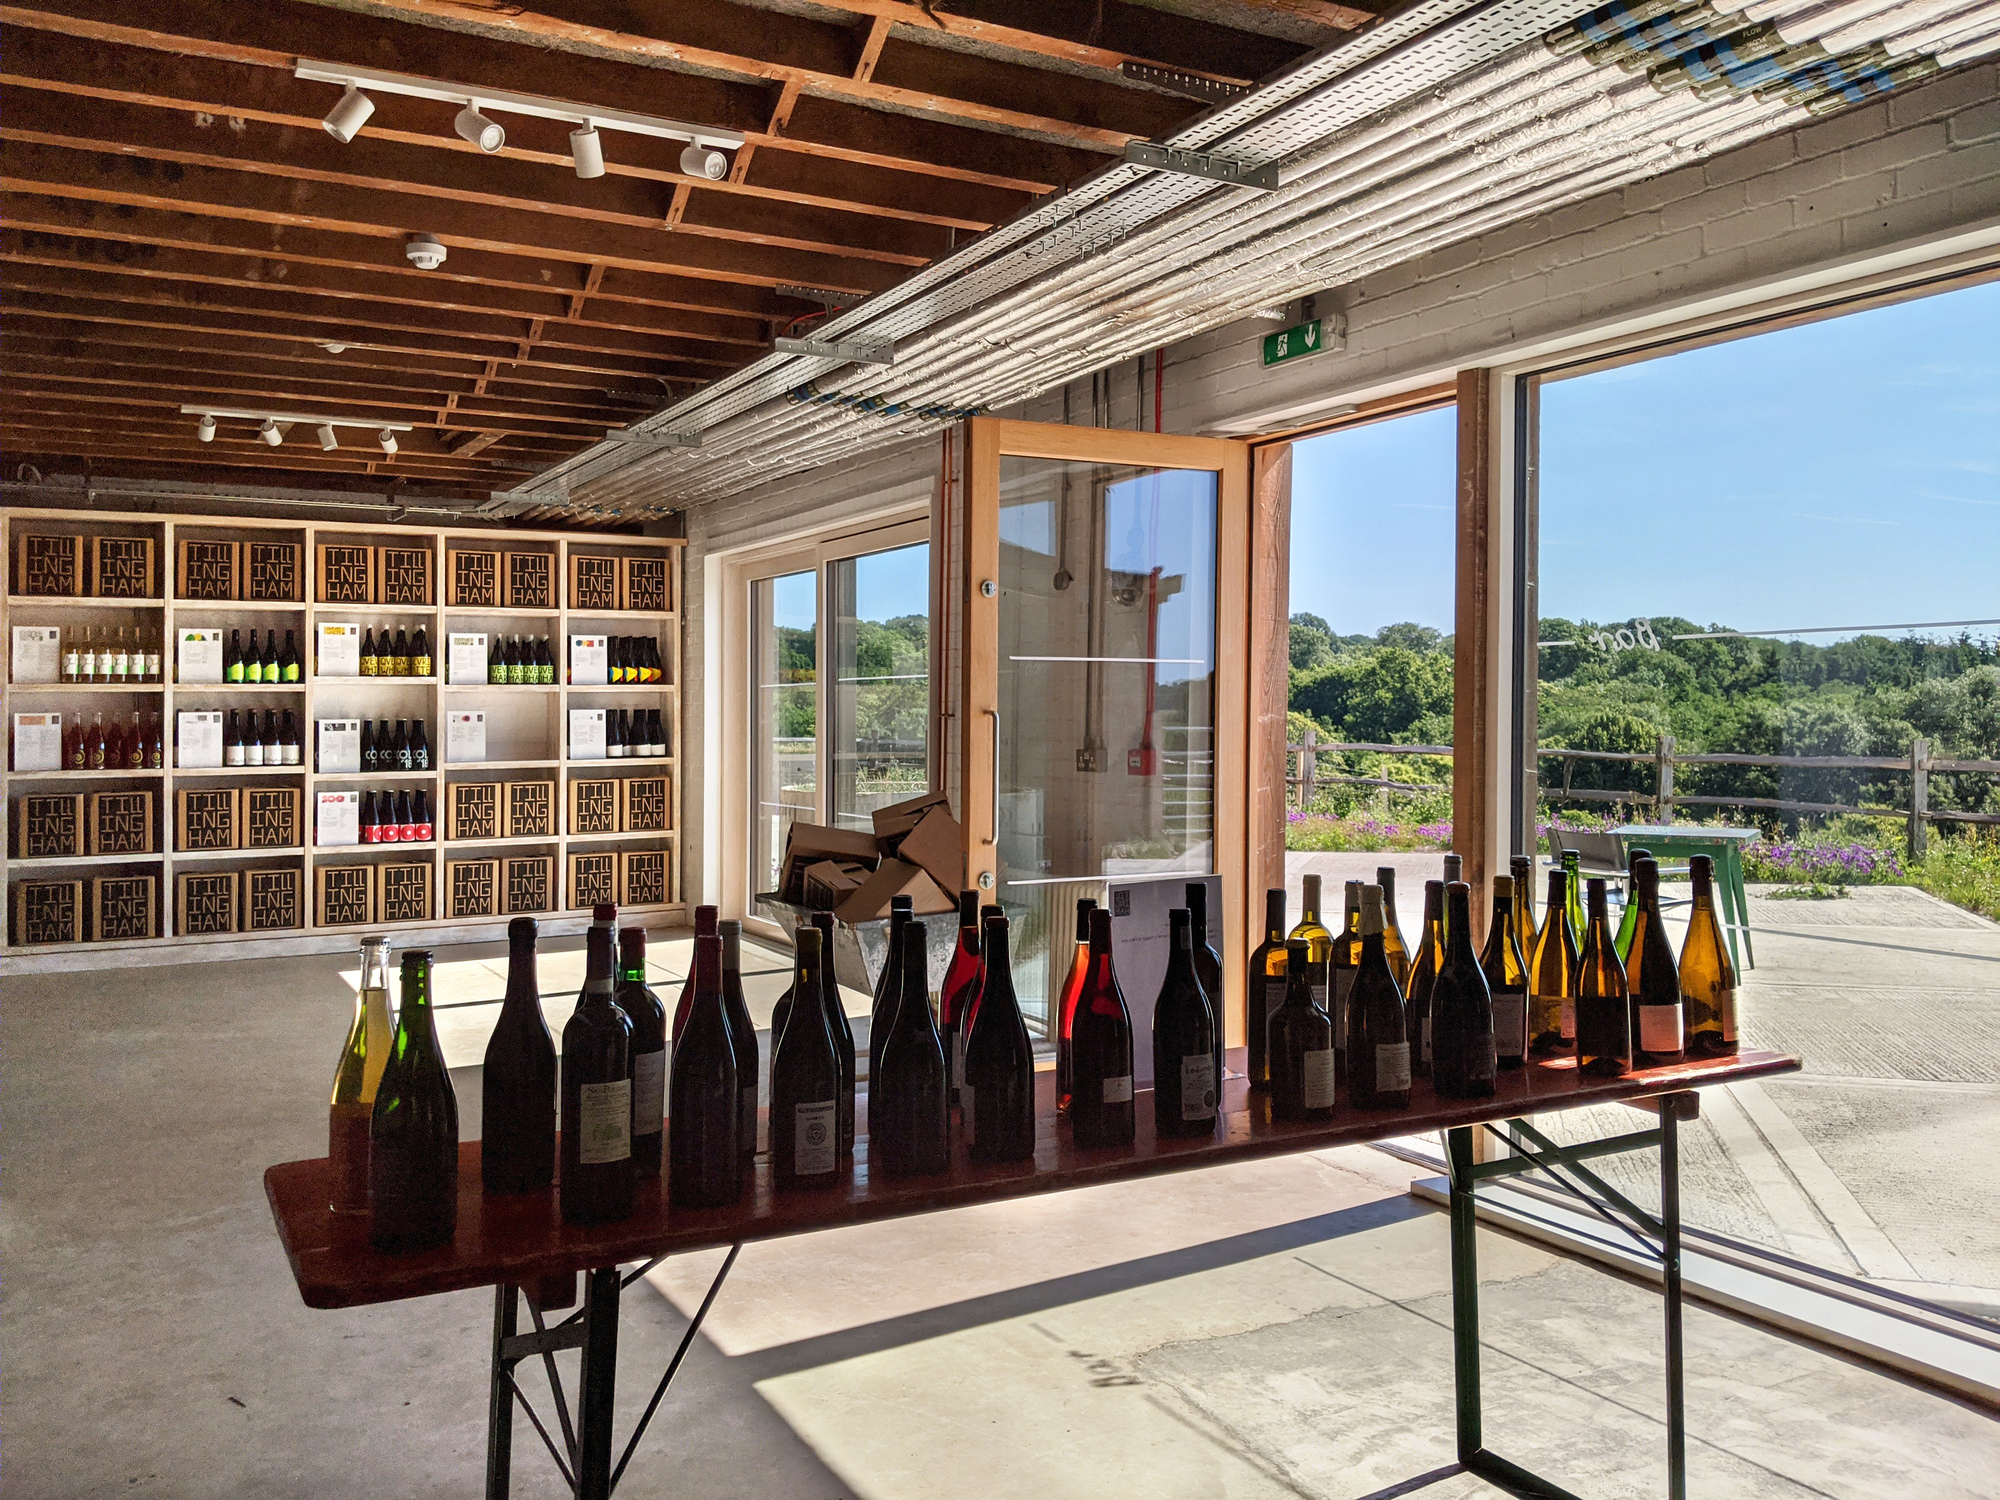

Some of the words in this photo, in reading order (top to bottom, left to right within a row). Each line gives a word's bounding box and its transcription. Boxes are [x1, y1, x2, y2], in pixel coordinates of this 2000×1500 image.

[1743, 26, 1762, 38] FLOW
[103, 542, 144, 559] TILL
[190, 544, 229, 562] TILL
[253, 546, 292, 563] TILL
[328, 549, 365, 565] TILL
[30, 556, 72, 574] ING
[387, 552, 423, 568] TILL
[458, 554, 492, 570] TILL
[513, 556, 546, 572] TILL
[580, 560, 612, 576] TILL
[103, 560, 144, 577] ING
[190, 562, 230, 579] ING
[254, 563, 292, 580] ING
[328, 566, 365, 582] ING
[631, 562, 662, 577] TILL
[30, 576, 73, 593] HAM
[387, 569, 424, 585] ING
[458, 571, 492, 587] ING
[513, 572, 547, 588] ING
[579, 576, 612, 592] ING
[631, 577, 663, 593] ING
[102, 579, 144, 594] HAM
[189, 580, 229, 597] HAM
[253, 581, 292, 597] HAM
[328, 583, 365, 599] HAM
[387, 586, 424, 601] HAM
[458, 587, 492, 603] HAM
[513, 589, 547, 604] HAM
[579, 592, 612, 607] HAM
[631, 593, 663, 608] HAM
[459, 787, 493, 803] TILL
[513, 786, 547, 801] TILL
[579, 783, 612, 798] TILL
[632, 782, 662, 796] TILL
[102, 797, 142, 814] TILL
[189, 793, 229, 810] TILL
[253, 792, 291, 809] TILL
[579, 799, 612, 815] ING
[631, 797, 663, 812] ING
[458, 803, 493, 820] ING
[513, 802, 547, 818] ING
[30, 817, 73, 834] ING
[102, 814, 143, 832] ING
[189, 811, 229, 828] ING
[252, 810, 291, 827] ING
[512, 818, 547, 834] HAM
[579, 815, 612, 830] HAM
[631, 813, 663, 828] HAM
[252, 828, 291, 844] HAM
[458, 820, 493, 836] HAM
[30, 835, 73, 853] HAM
[101, 833, 143, 850] HAM
[189, 829, 229, 846] HAM
[511, 861, 545, 877] TILL
[578, 858, 610, 873] TILL
[630, 855, 661, 870] TILL
[328, 871, 364, 887] TILL
[387, 868, 423, 884] TILL
[456, 864, 490, 881] TILL
[630, 871, 662, 887] ING
[189, 878, 228, 895] TILL
[254, 874, 292, 891] TILL
[511, 877, 545, 894] ING
[578, 873, 610, 889] ING
[104, 882, 145, 899] TILL
[327, 888, 364, 905] ING
[387, 885, 423, 901] ING
[456, 881, 490, 898] ING
[577, 889, 610, 905] HAM
[630, 886, 662, 902] HAM
[189, 895, 229, 914] ING
[254, 891, 292, 909] ING
[455, 898, 490, 914] HAM
[510, 894, 545, 910] HAM
[29, 904, 72, 922] ING
[104, 900, 145, 918] ING
[327, 905, 365, 921] HAM
[387, 901, 423, 918] HAM
[189, 914, 229, 930] HAM
[254, 909, 293, 926] HAM
[29, 923, 72, 940] HAM
[103, 918, 146, 936] HAM
